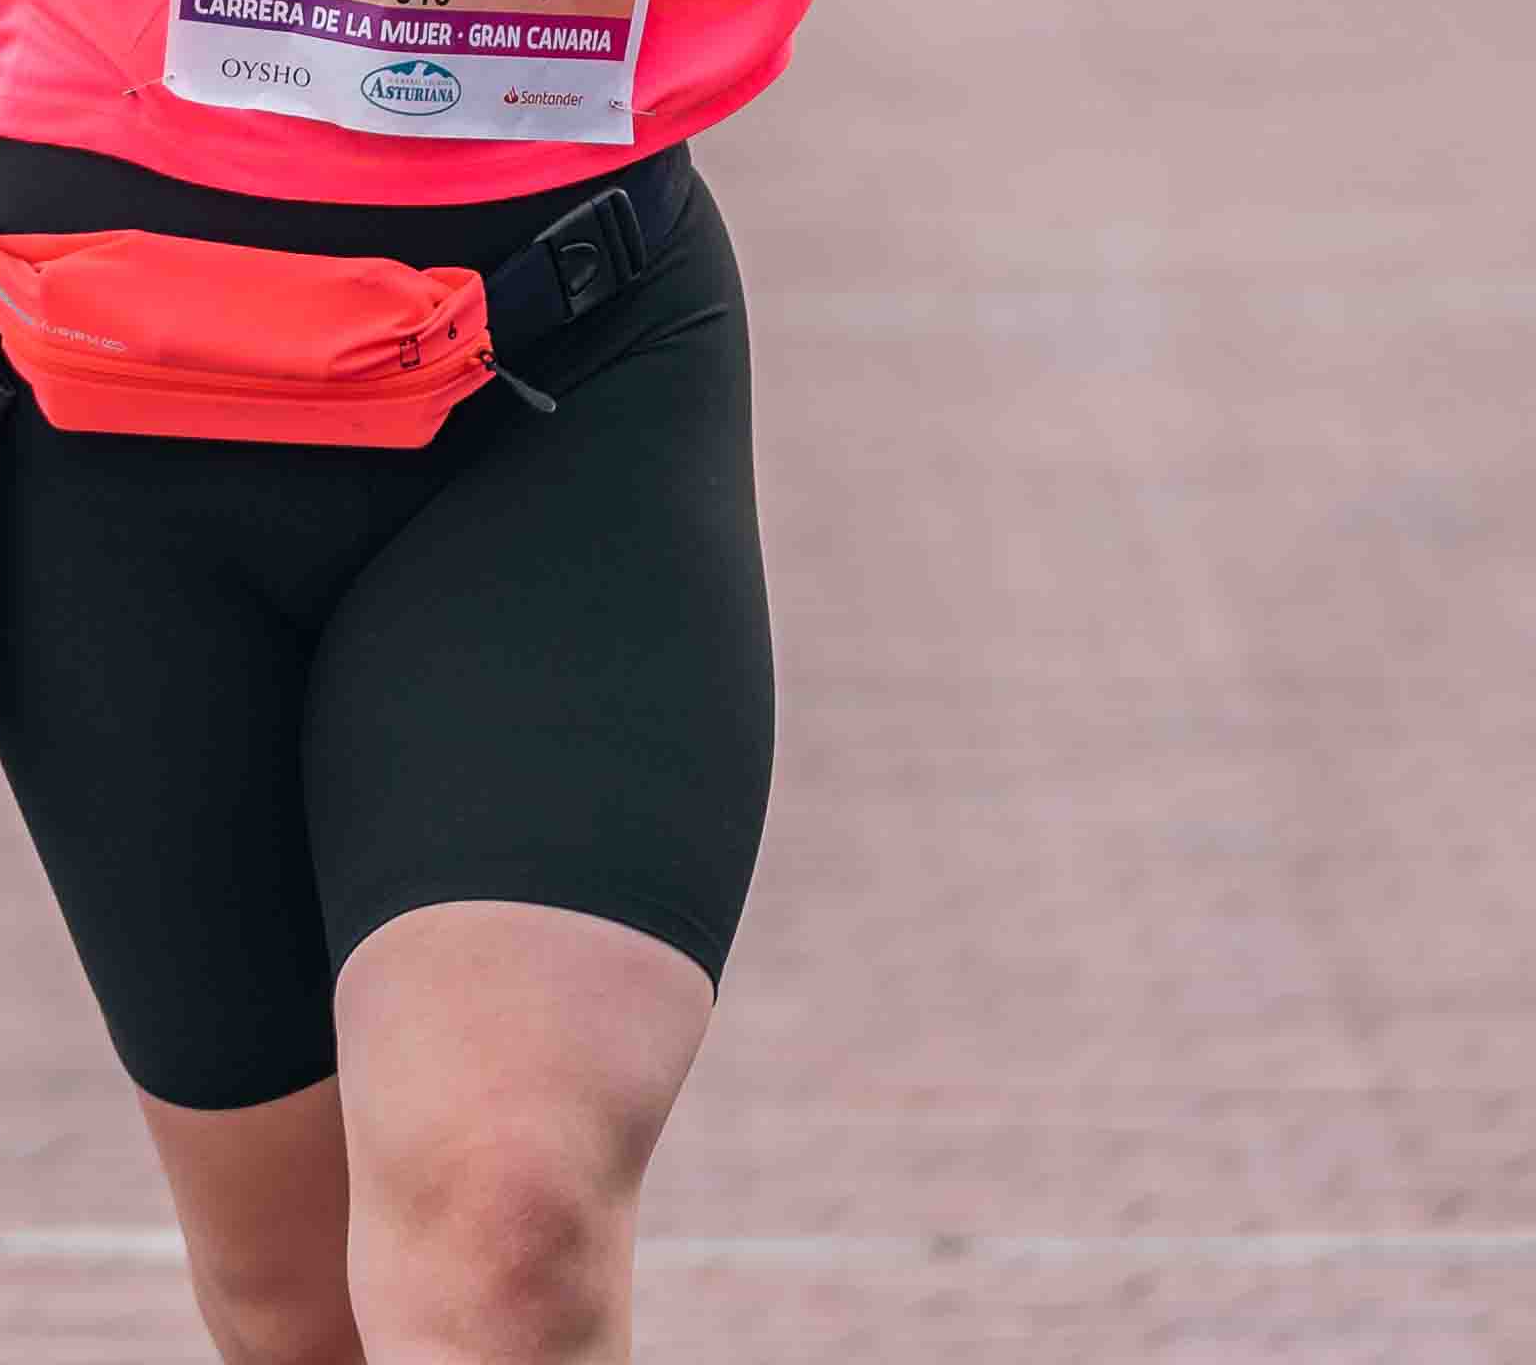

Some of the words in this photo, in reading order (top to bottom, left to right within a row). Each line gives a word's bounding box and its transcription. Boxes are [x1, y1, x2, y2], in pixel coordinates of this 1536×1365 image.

[312, 5, 341, 32] DE
[345, 13, 372, 40] LA
[380, 20, 452, 46] MUJER
[469, 25, 520, 49] GRAN
[527, 27, 612, 53] CANARIA
[221, 58, 311, 88] OYSHO
[369, 77, 454, 102] ASTURIANA
[520, 91, 585, 108] Santander
